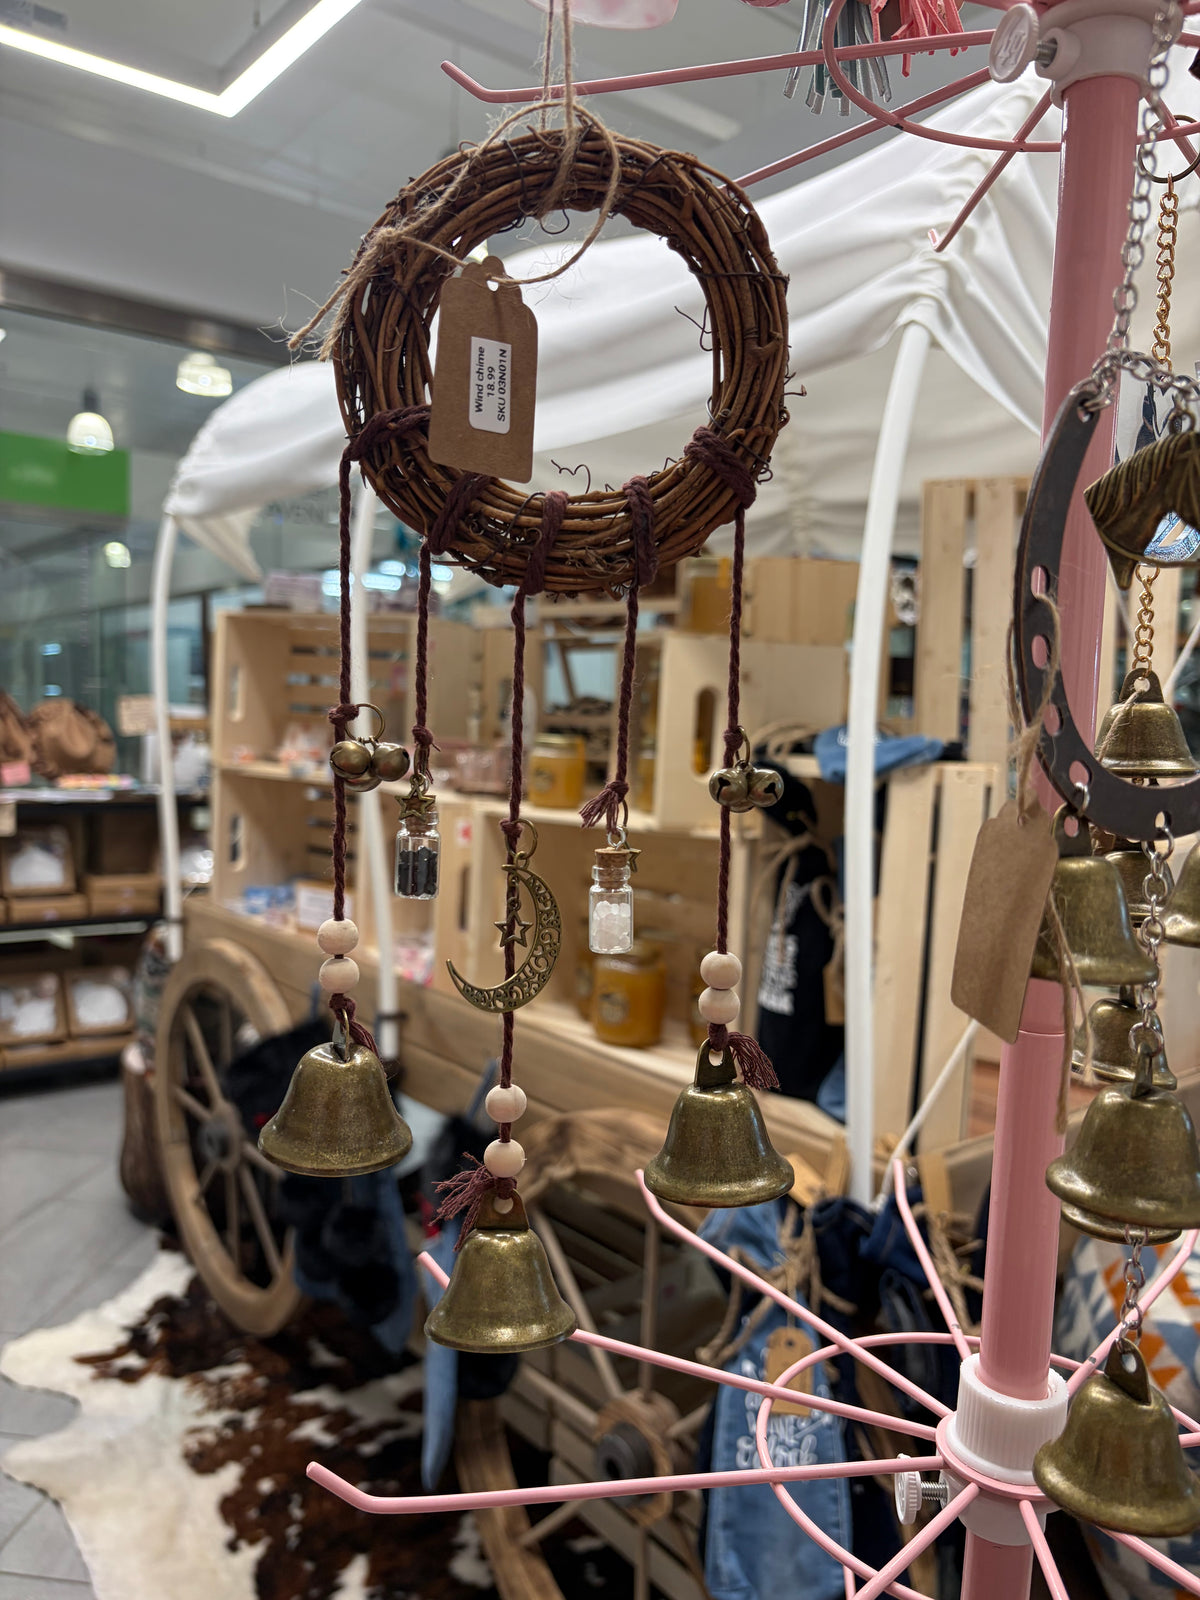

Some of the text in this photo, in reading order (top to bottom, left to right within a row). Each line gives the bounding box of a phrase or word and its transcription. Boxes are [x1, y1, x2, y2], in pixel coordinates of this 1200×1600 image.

[475, 346, 485, 413] Wind chime
[487, 366, 495, 397] 18.99
[497, 349, 507, 422] SKU 03N01N
